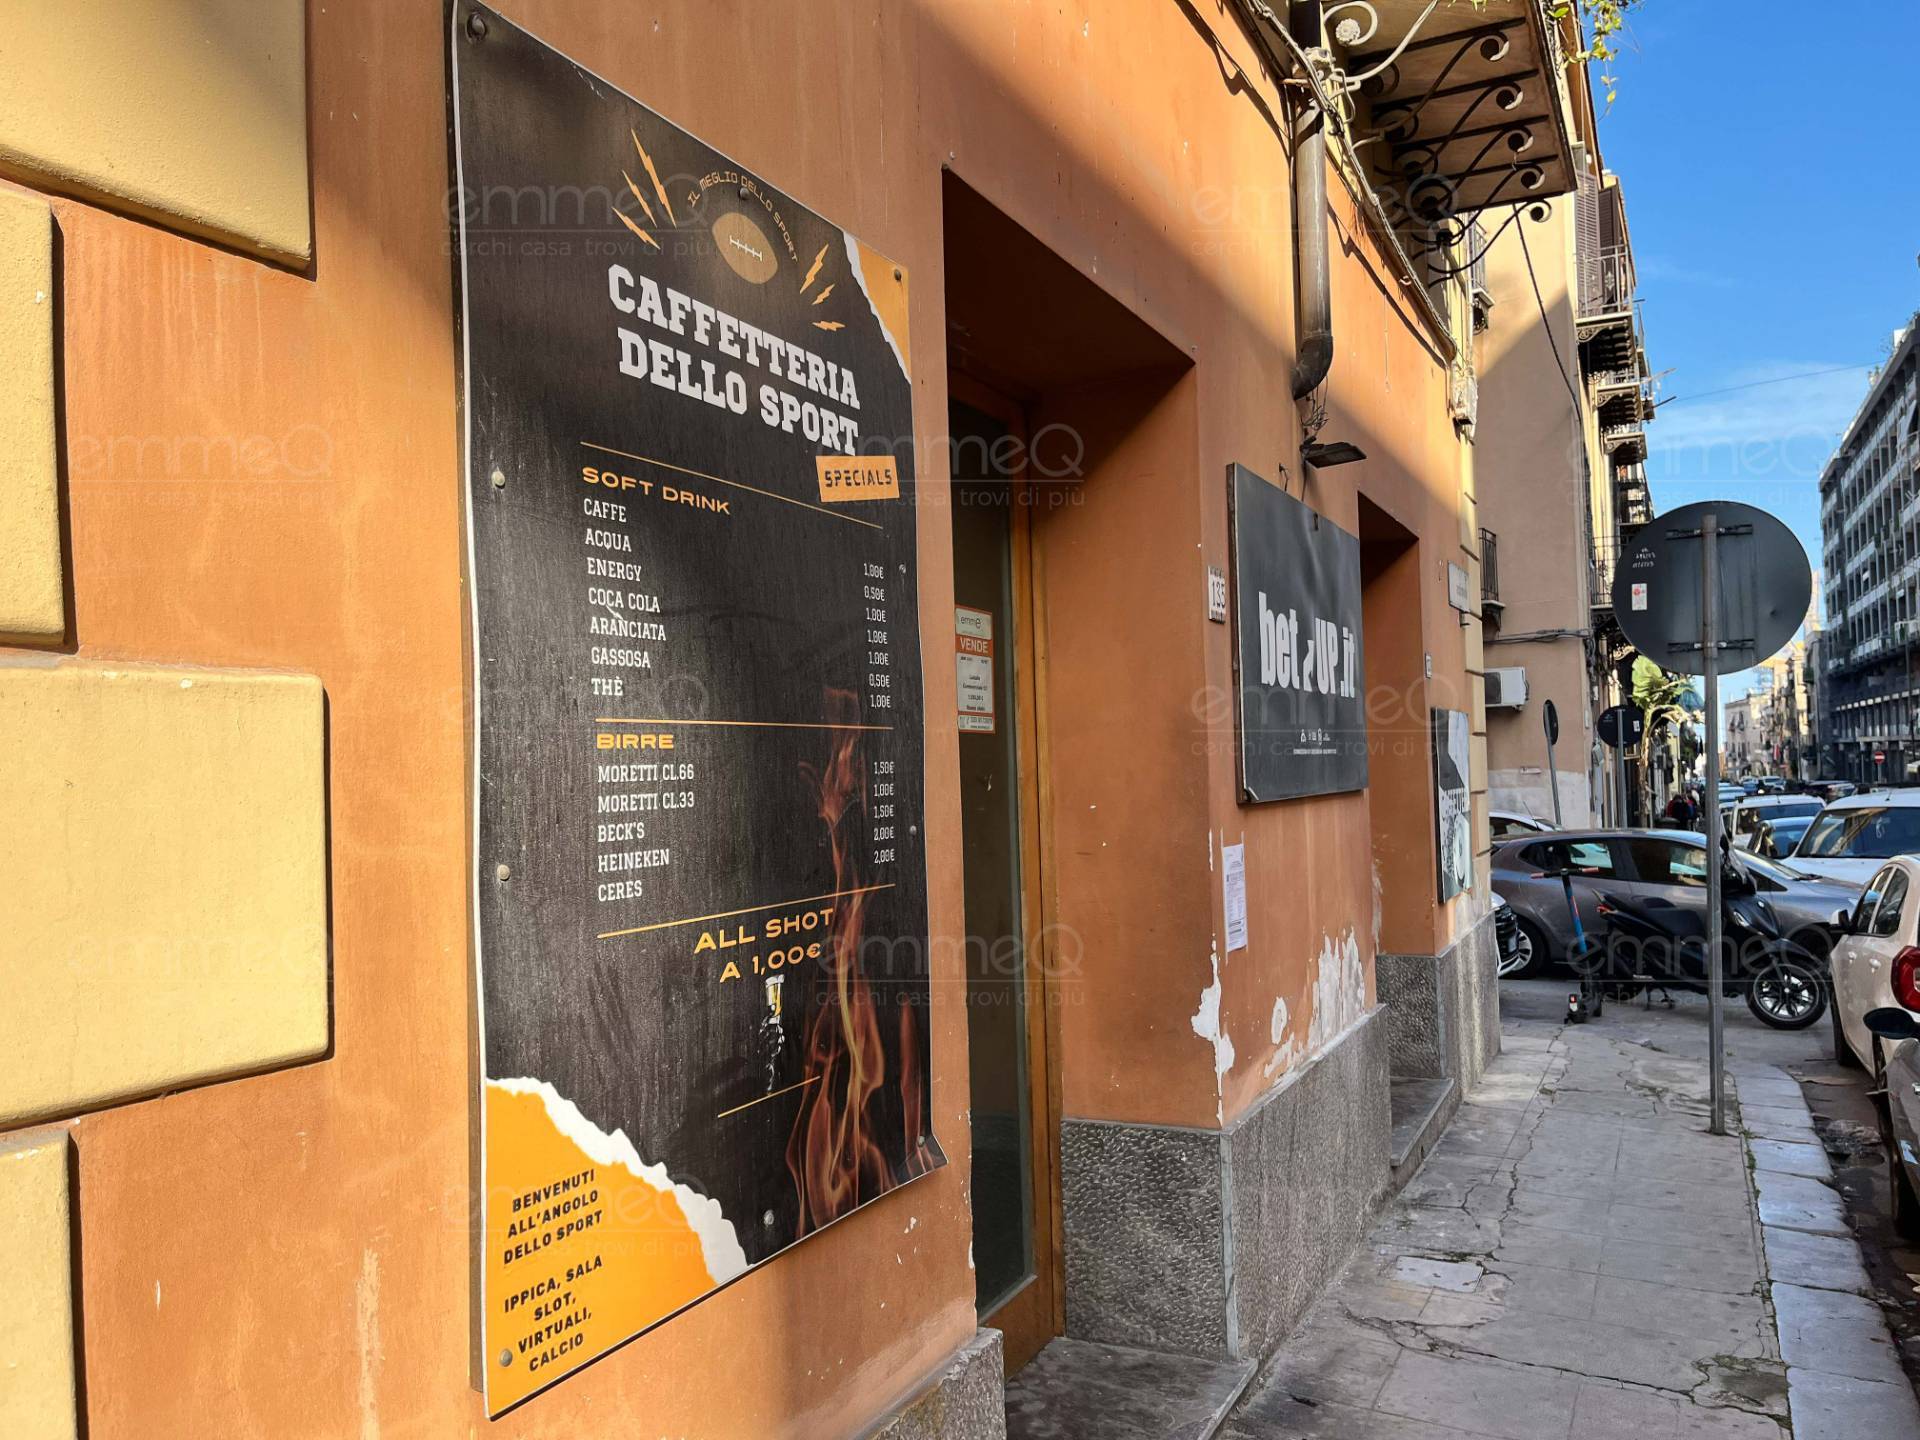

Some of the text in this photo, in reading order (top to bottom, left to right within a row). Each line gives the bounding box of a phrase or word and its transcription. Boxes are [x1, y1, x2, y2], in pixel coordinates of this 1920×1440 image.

[687, 171, 798, 262] IL MEGLIO DELLO SPORT
[608, 263, 860, 409] CAFFETTERIA
[617, 327, 859, 456] DELLO SPORT
[582, 466, 731, 515] SOFT DRINK
[825, 468, 892, 489] SPECIALS
[584, 498, 627, 523] CAFFE
[585, 528, 632, 552] ACQUA
[587, 557, 642, 582] ENERGY
[589, 586, 661, 613] COCA COLA
[590, 616, 667, 642] ARANCIATA
[1259, 591, 1300, 690] bet
[591, 646, 651, 669] GASSOSA
[960, 636, 989, 653] VENDE
[596, 734, 675, 750] BIRRE
[598, 763, 695, 783] MORETTI CL.66
[598, 791, 695, 813] MORETTI CL.33
[598, 822, 645, 843] BECK'S
[598, 849, 670, 873] HEINEKEN
[598, 880, 643, 902] CERES
[694, 908, 834, 954] ALL SHOT
[719, 942, 822, 983] A 1,00€
[512, 1168, 595, 1213] BENVENUTI
[507, 1189, 599, 1238] ALL'ANGOLO
[503, 1233, 552, 1265] DELLO
[556, 1209, 603, 1247] SPORT
[504, 1255, 603, 1313] IPPICA, SALA
[534, 1291, 577, 1321] SLOT,
[517, 1308, 593, 1354] VIRTUALI,
[528, 1333, 585, 1373] CALCIO
